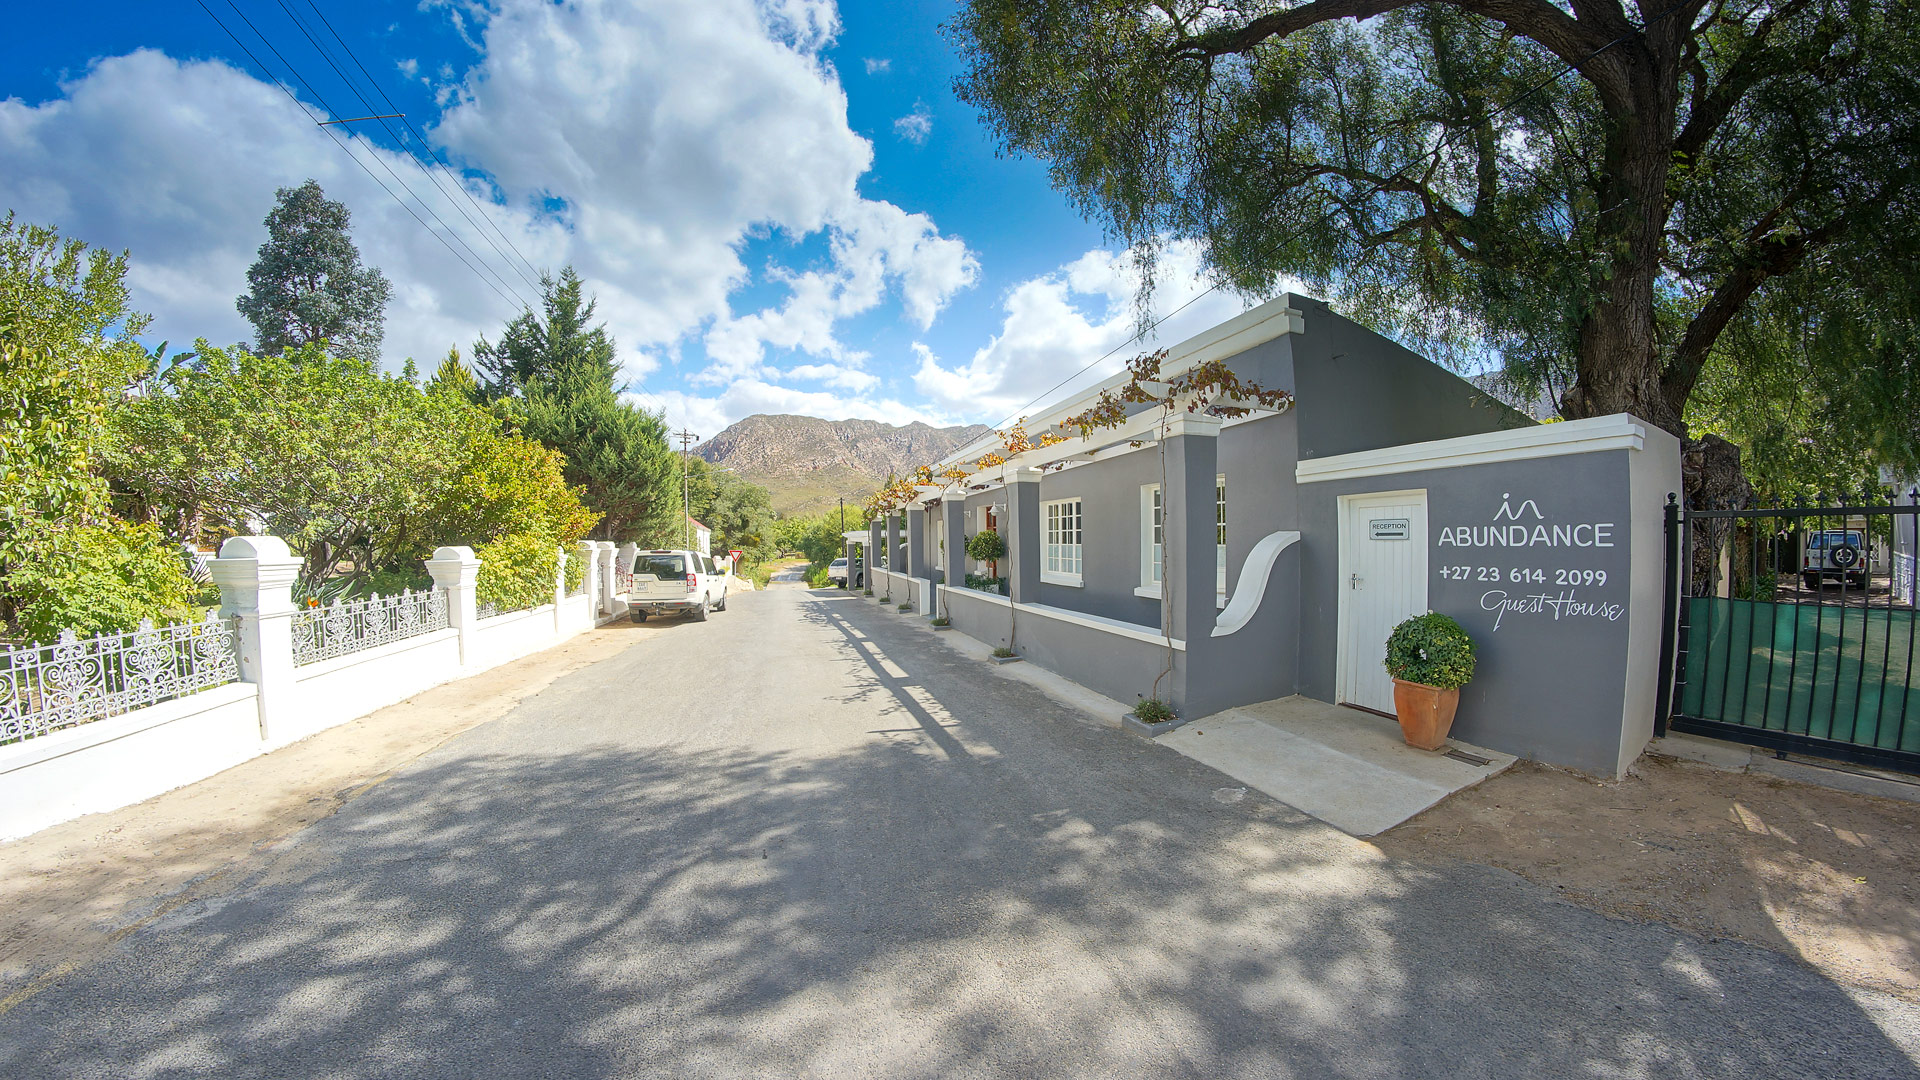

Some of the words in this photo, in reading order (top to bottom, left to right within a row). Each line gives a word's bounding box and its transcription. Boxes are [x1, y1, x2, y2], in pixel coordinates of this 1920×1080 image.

[1438, 523, 1614, 547] ABUNDANCE
[1439, 565, 1471, 580] +27
[1477, 566, 1500, 582] 23
[1509, 568, 1546, 584] 614
[1555, 569, 1607, 587] 2099
[1480, 589, 1553, 632] Guest
[1545, 589, 1625, 621] House
